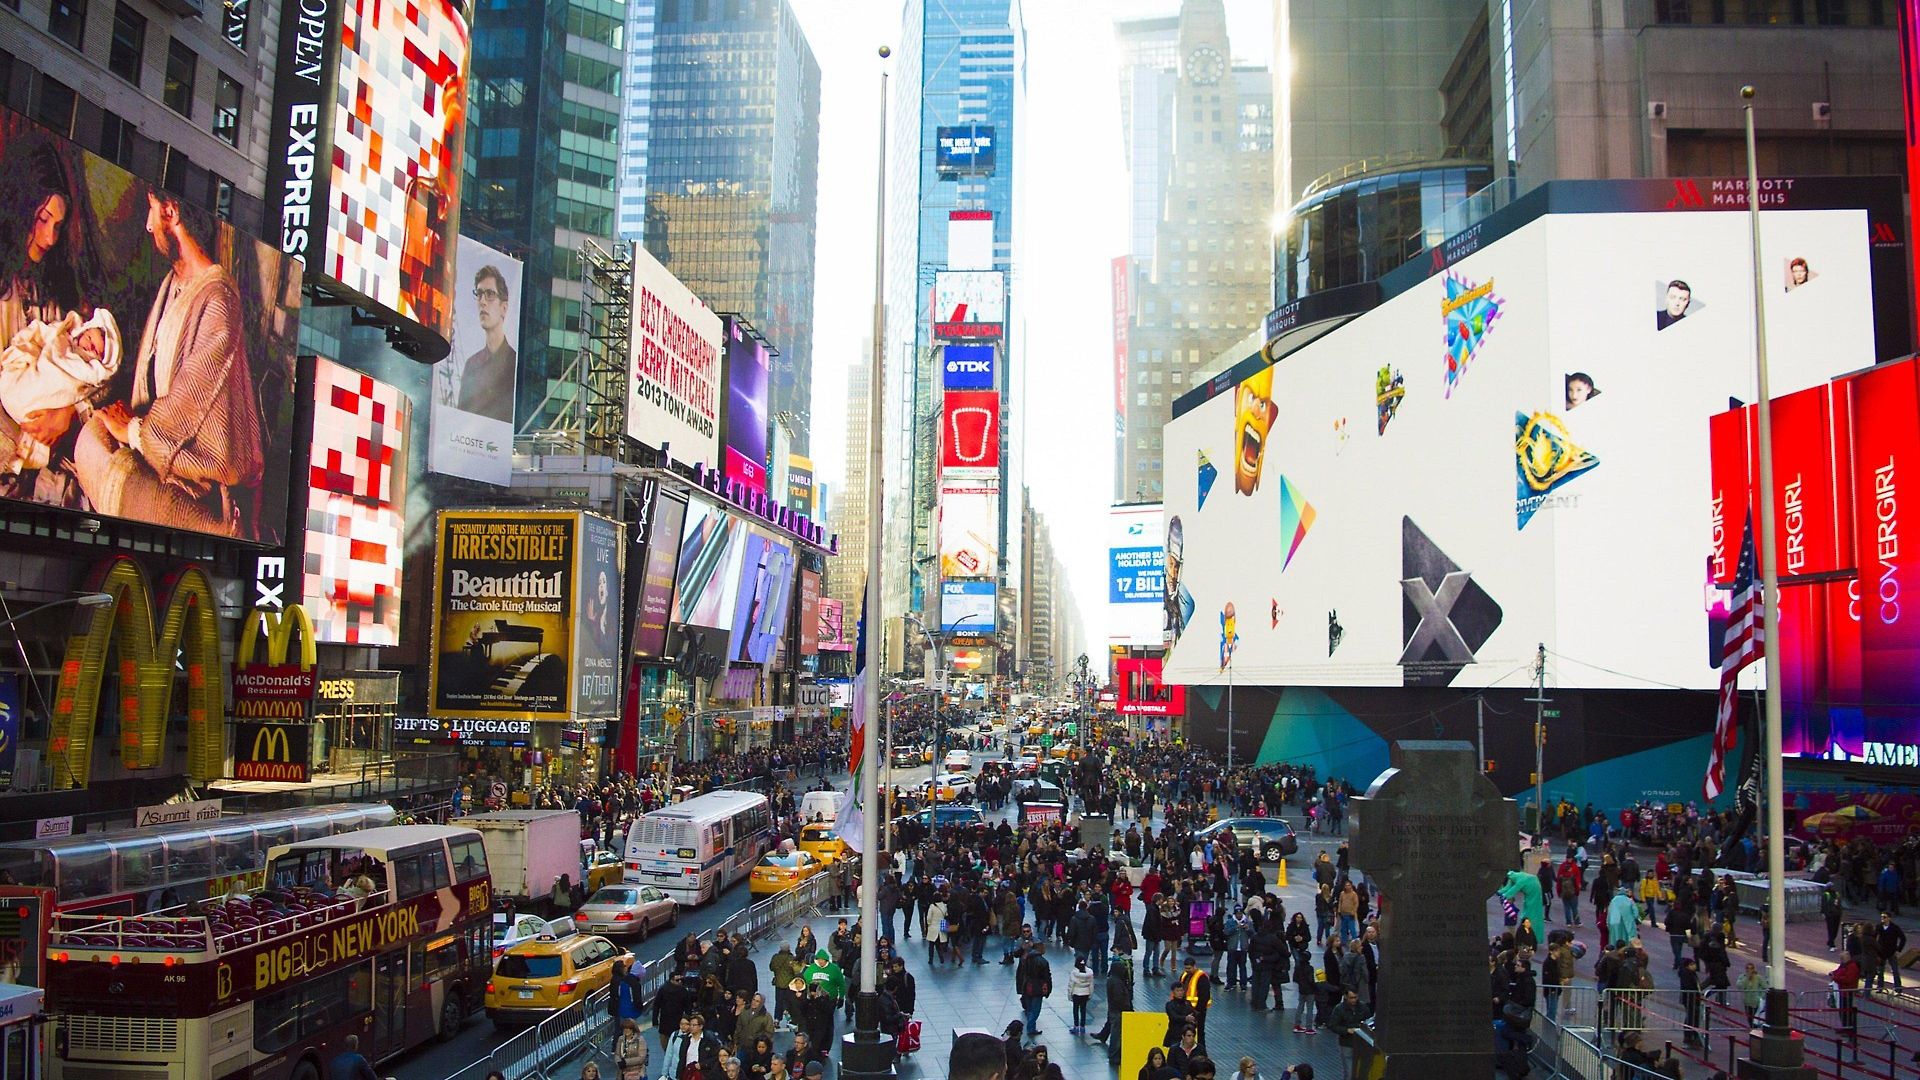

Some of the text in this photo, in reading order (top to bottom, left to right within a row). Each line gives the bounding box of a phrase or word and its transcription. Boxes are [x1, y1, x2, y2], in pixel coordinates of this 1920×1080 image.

[1712, 179, 1795, 190] MARIOTT
[1713, 193, 1785, 204] MARUIS
[1446, 223, 1482, 251] MARRIOTT
[1446, 238, 1478, 263] MARQUIS
[640, 286, 662, 341] BEST
[957, 361, 990, 372] TDK
[638, 334, 715, 420] JERRY MITCHELL
[637, 374, 714, 440] 2013 TONY AWARD
[449, 432, 484, 449] LACOSTE
[748, 488, 825, 545] BROADWAY
[507, 525, 519, 535] THE
[520, 525, 542, 535] RANKS
[543, 525, 552, 535] OF
[552, 525, 565, 535] THE
[1711, 490, 1726, 582] ERGIRL
[1874, 454, 1900, 625] COVERGIRL
[1117, 559, 1152, 567] HOLIDAY
[450, 569, 563, 598] Beautiful
[944, 584, 965, 594] FOX
[1116, 578, 1132, 592] 17
[450, 599, 562, 614] The Carole King Musical
[235, 674, 312, 686] McDonald's
[581, 673, 614, 699] IF/THEN
[247, 687, 298, 695] Restaurant
[452, 719, 531, 734] LUGGAGE
[150, 810, 191, 823] Summit
[45, 820, 70, 833] Summit
[332, 921, 375, 963] NEW
[376, 904, 420, 946] YORK
